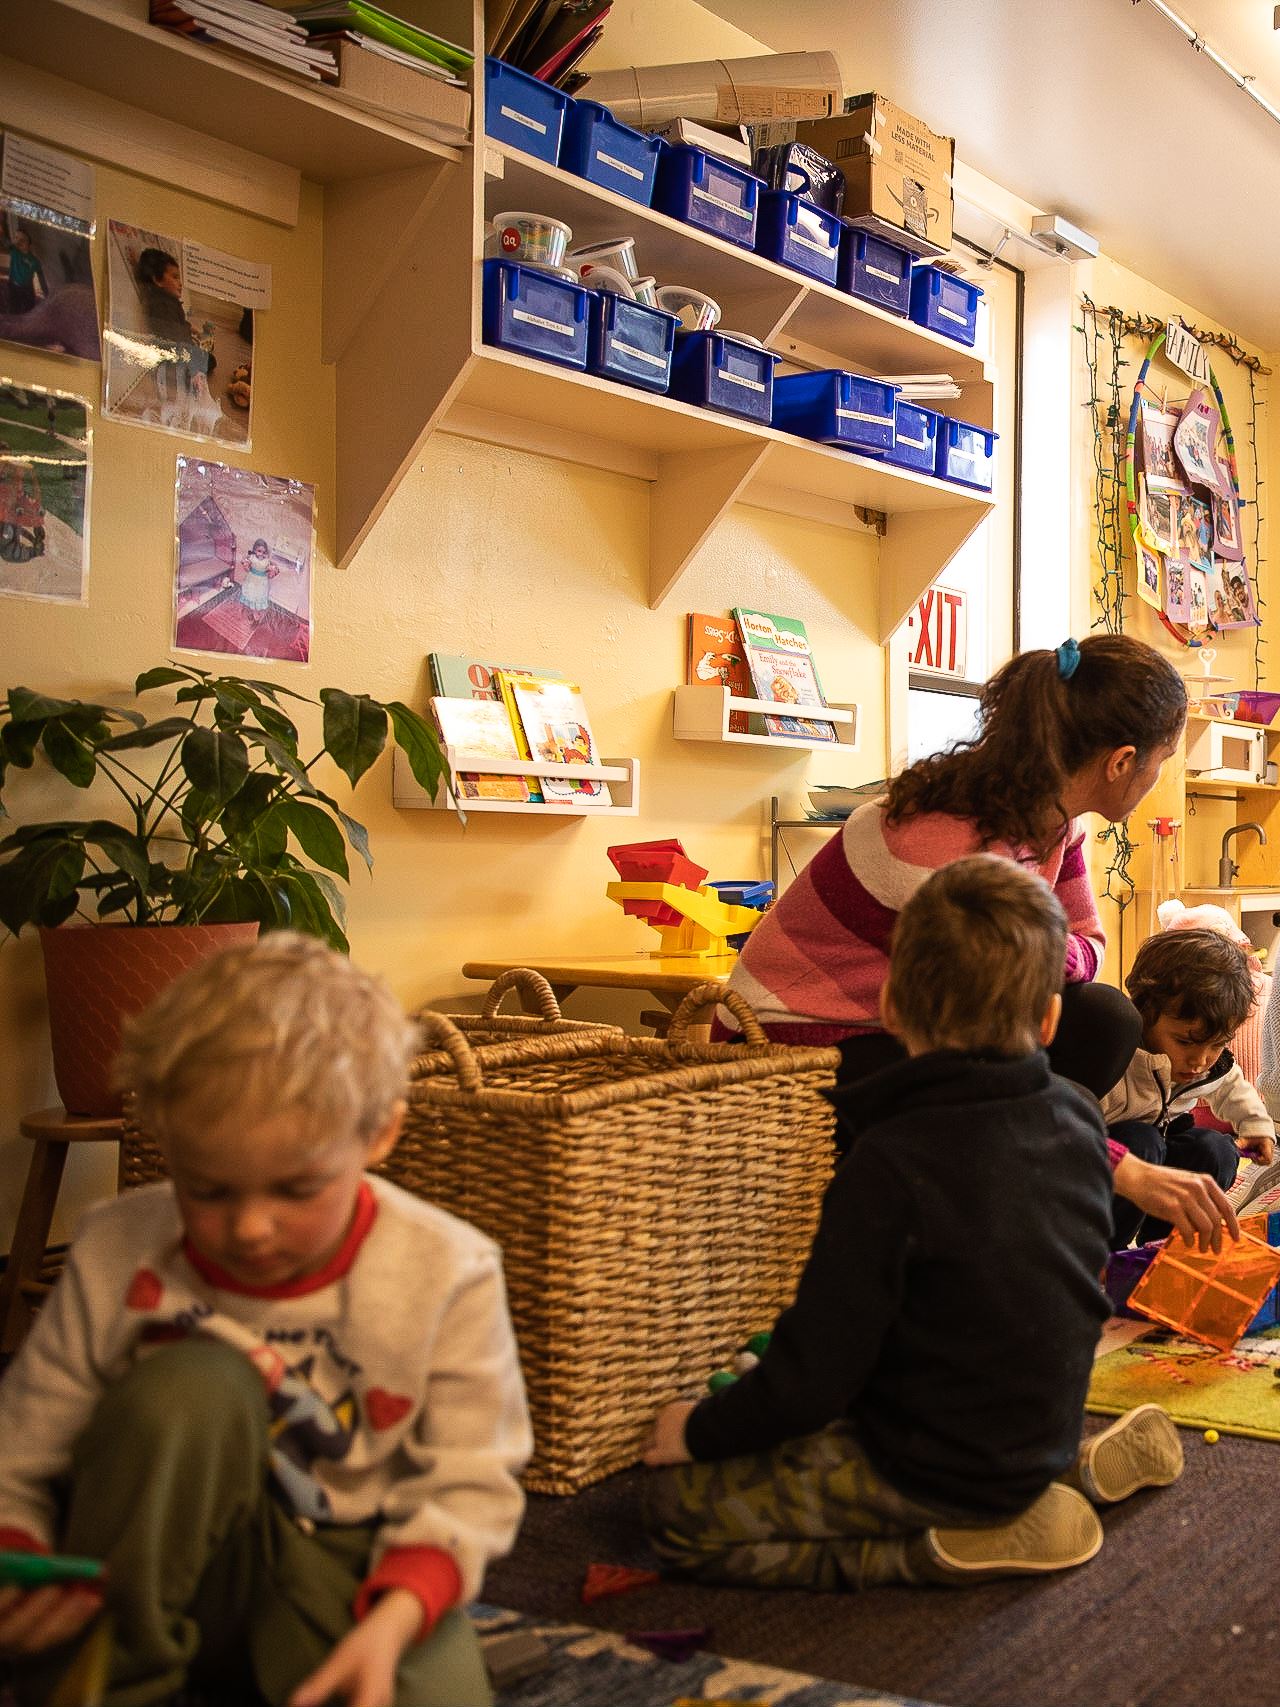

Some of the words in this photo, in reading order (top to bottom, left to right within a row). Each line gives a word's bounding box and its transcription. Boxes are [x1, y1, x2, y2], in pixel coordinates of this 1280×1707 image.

[891, 130, 905, 144] LESS
[906, 139, 936, 162] MATERIAL
[896, 124, 914, 140] MADE
[914, 135, 931, 150] WITH
[1167, 322, 1208, 381] FAMILY
[704, 624, 724, 643] Seuss
[744, 617, 772, 634] Horton
[908, 590, 962, 671] XIT
[774, 634, 807, 650] Hatches
[758, 652, 778, 666] Emily
[771, 664, 807, 679] Snowflake
